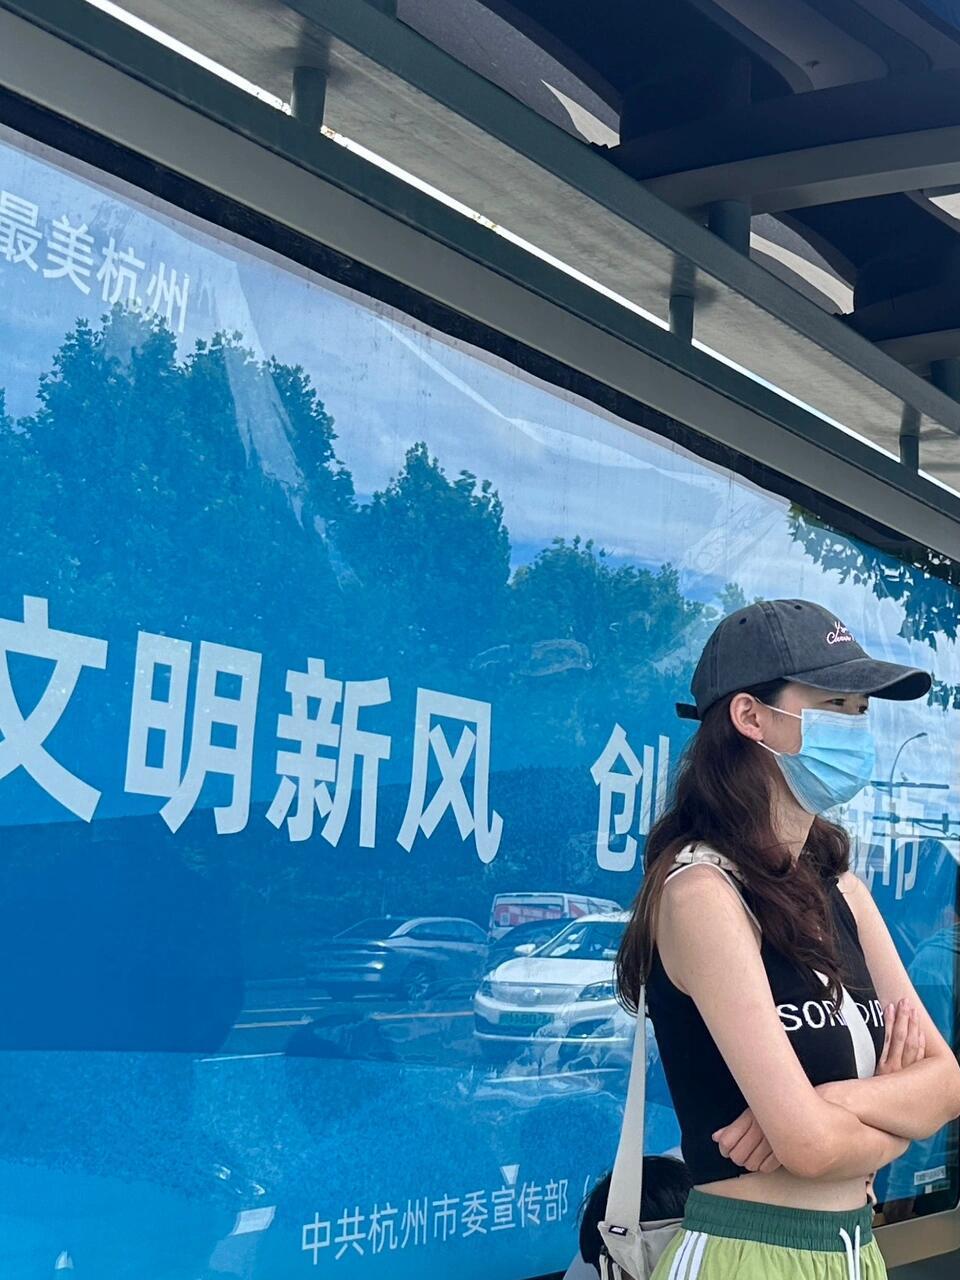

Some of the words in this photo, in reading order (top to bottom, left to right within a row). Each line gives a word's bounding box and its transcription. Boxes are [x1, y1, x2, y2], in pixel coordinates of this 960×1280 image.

[0, 190, 190, 333] 最美杭州
[0, 594, 504, 865] 文明新风
[590, 722, 670, 873] 创
